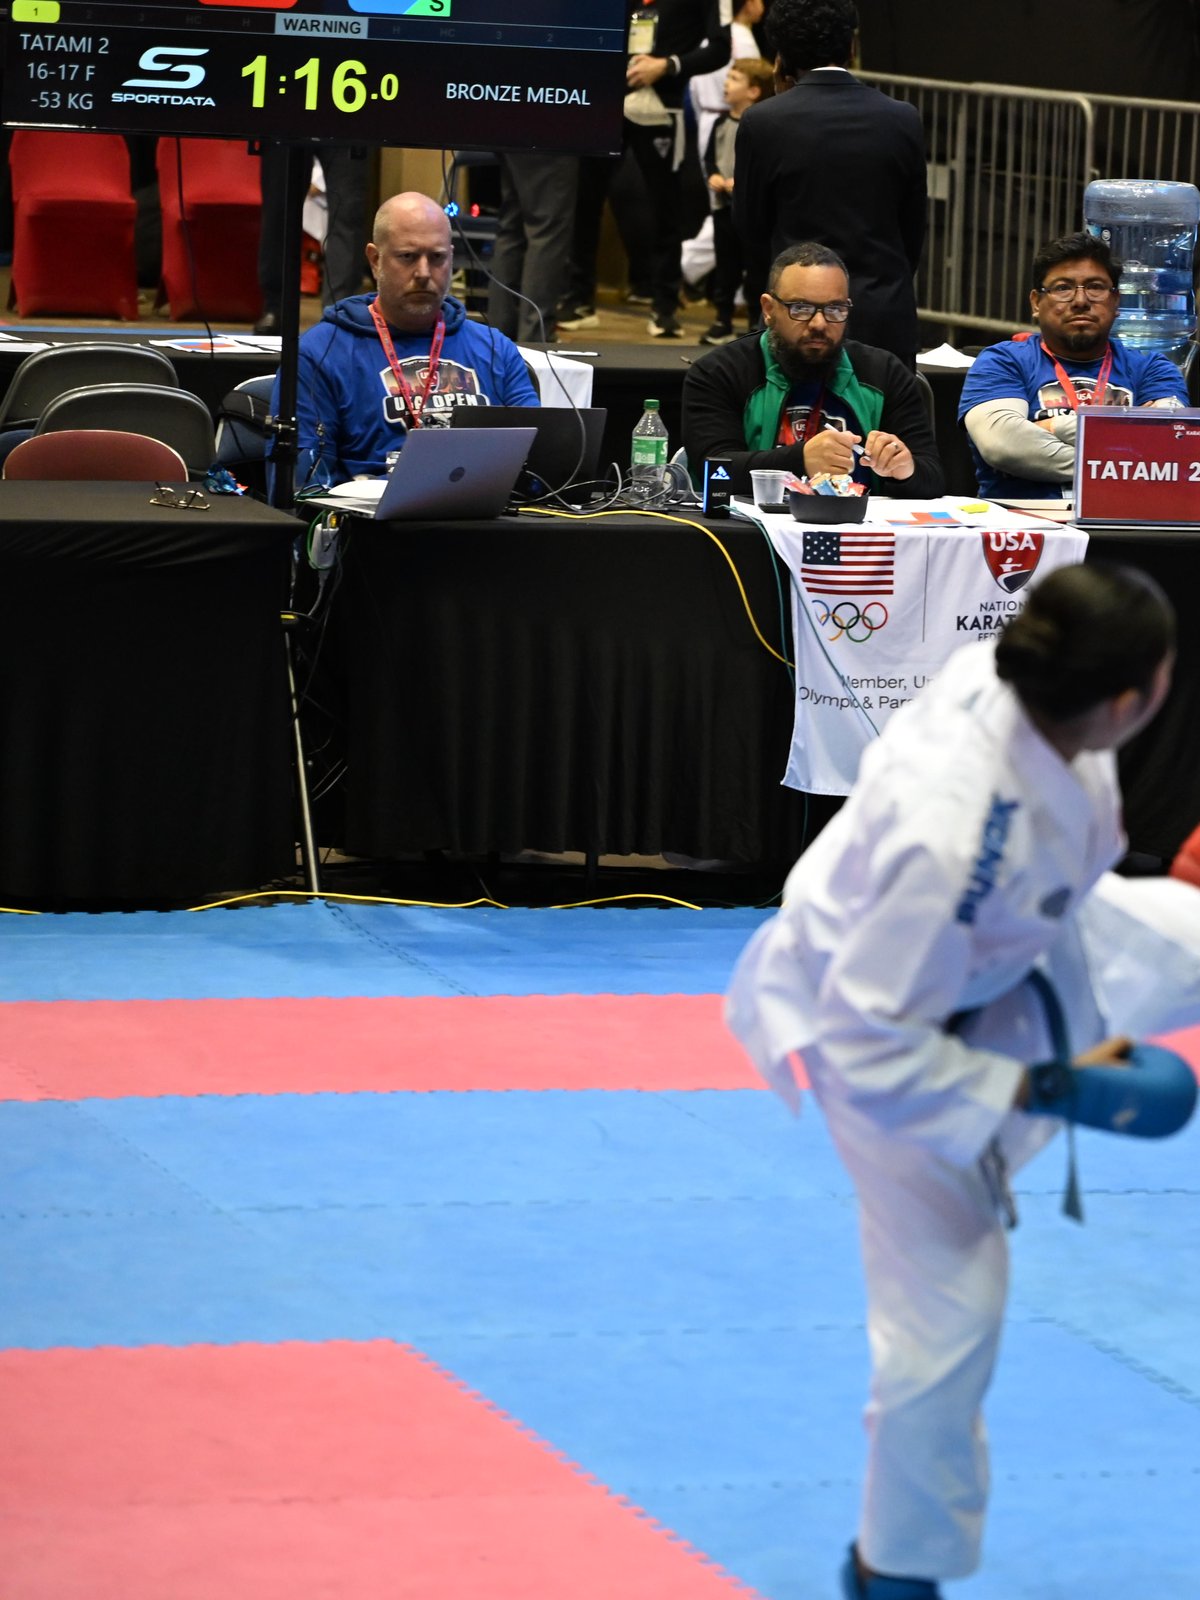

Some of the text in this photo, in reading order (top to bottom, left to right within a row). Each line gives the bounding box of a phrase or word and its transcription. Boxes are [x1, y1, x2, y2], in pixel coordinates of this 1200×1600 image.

[33, 8, 38, 16] 1
[283, 18, 361, 35] WARNING
[20, 34, 109, 54] TATAMI 2
[27, 62, 96, 81] 16-17 F
[242, 55, 399, 113] 1:16.0
[446, 83, 591, 105] BRONZE MEDAL
[31, 92, 94, 110] -53 KG
[111, 93, 216, 107] SPORTDATA
[394, 395, 426, 411] UA
[432, 393, 478, 408] OPEN
[1087, 460, 1178, 481] TATAMI
[990, 532, 1036, 552] USA
[863, 696, 873, 709] &
